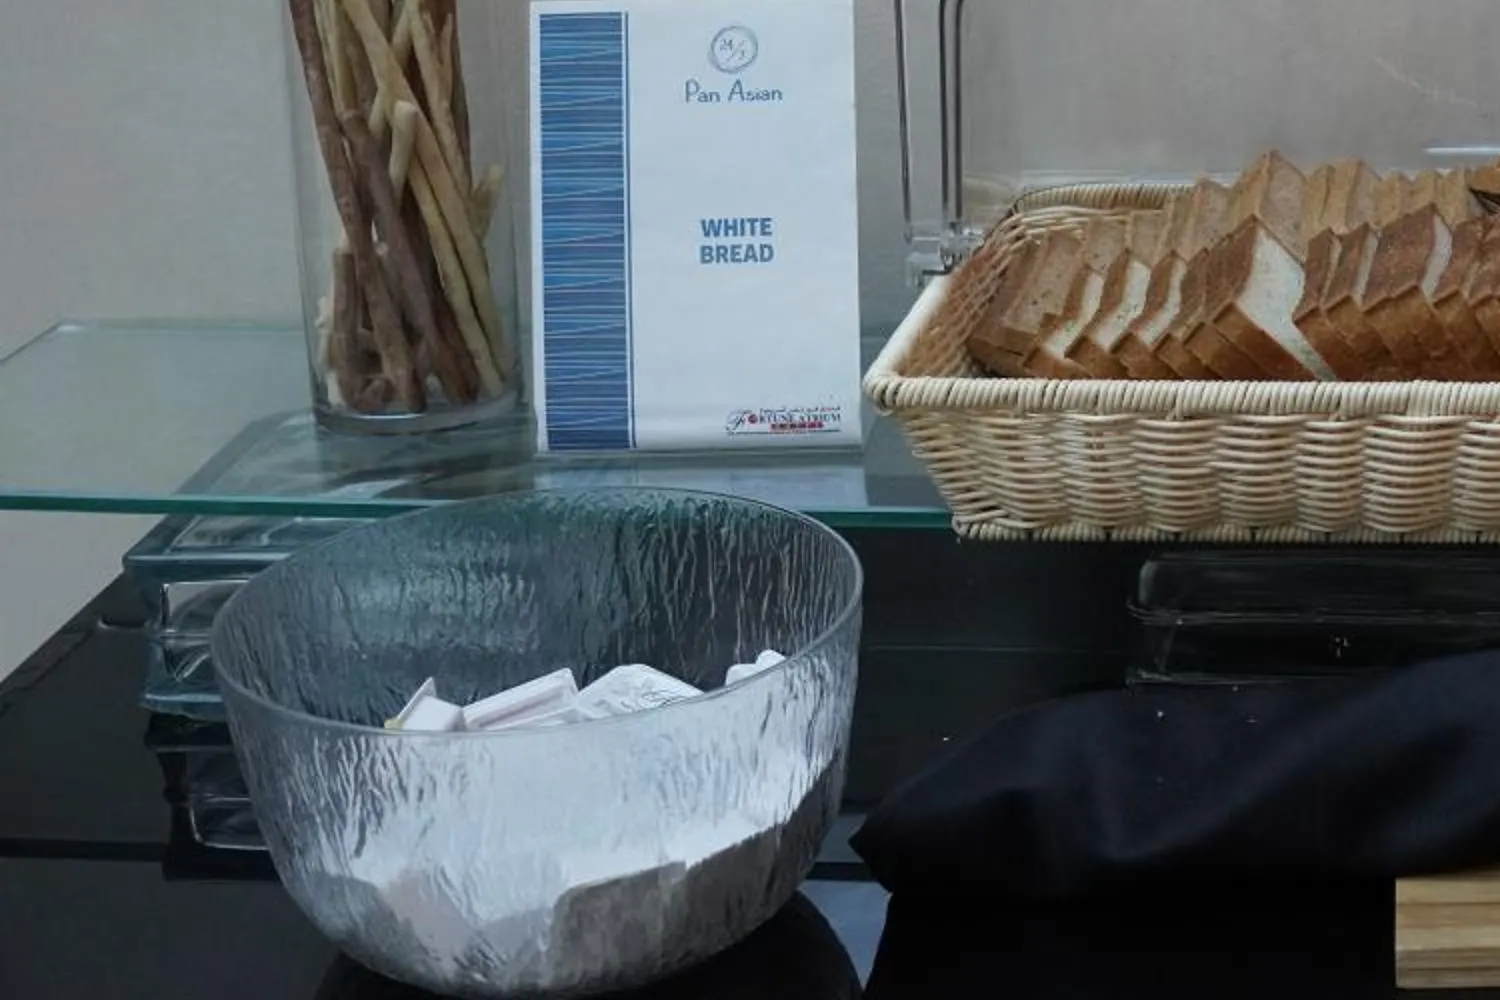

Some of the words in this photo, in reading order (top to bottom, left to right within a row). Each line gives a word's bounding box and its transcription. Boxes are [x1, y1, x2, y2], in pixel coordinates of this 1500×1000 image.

[685, 78, 721, 103] Pan
[727, 78, 784, 102] Asian
[700, 217, 773, 237] WHITE
[700, 244, 774, 264] BREAD
